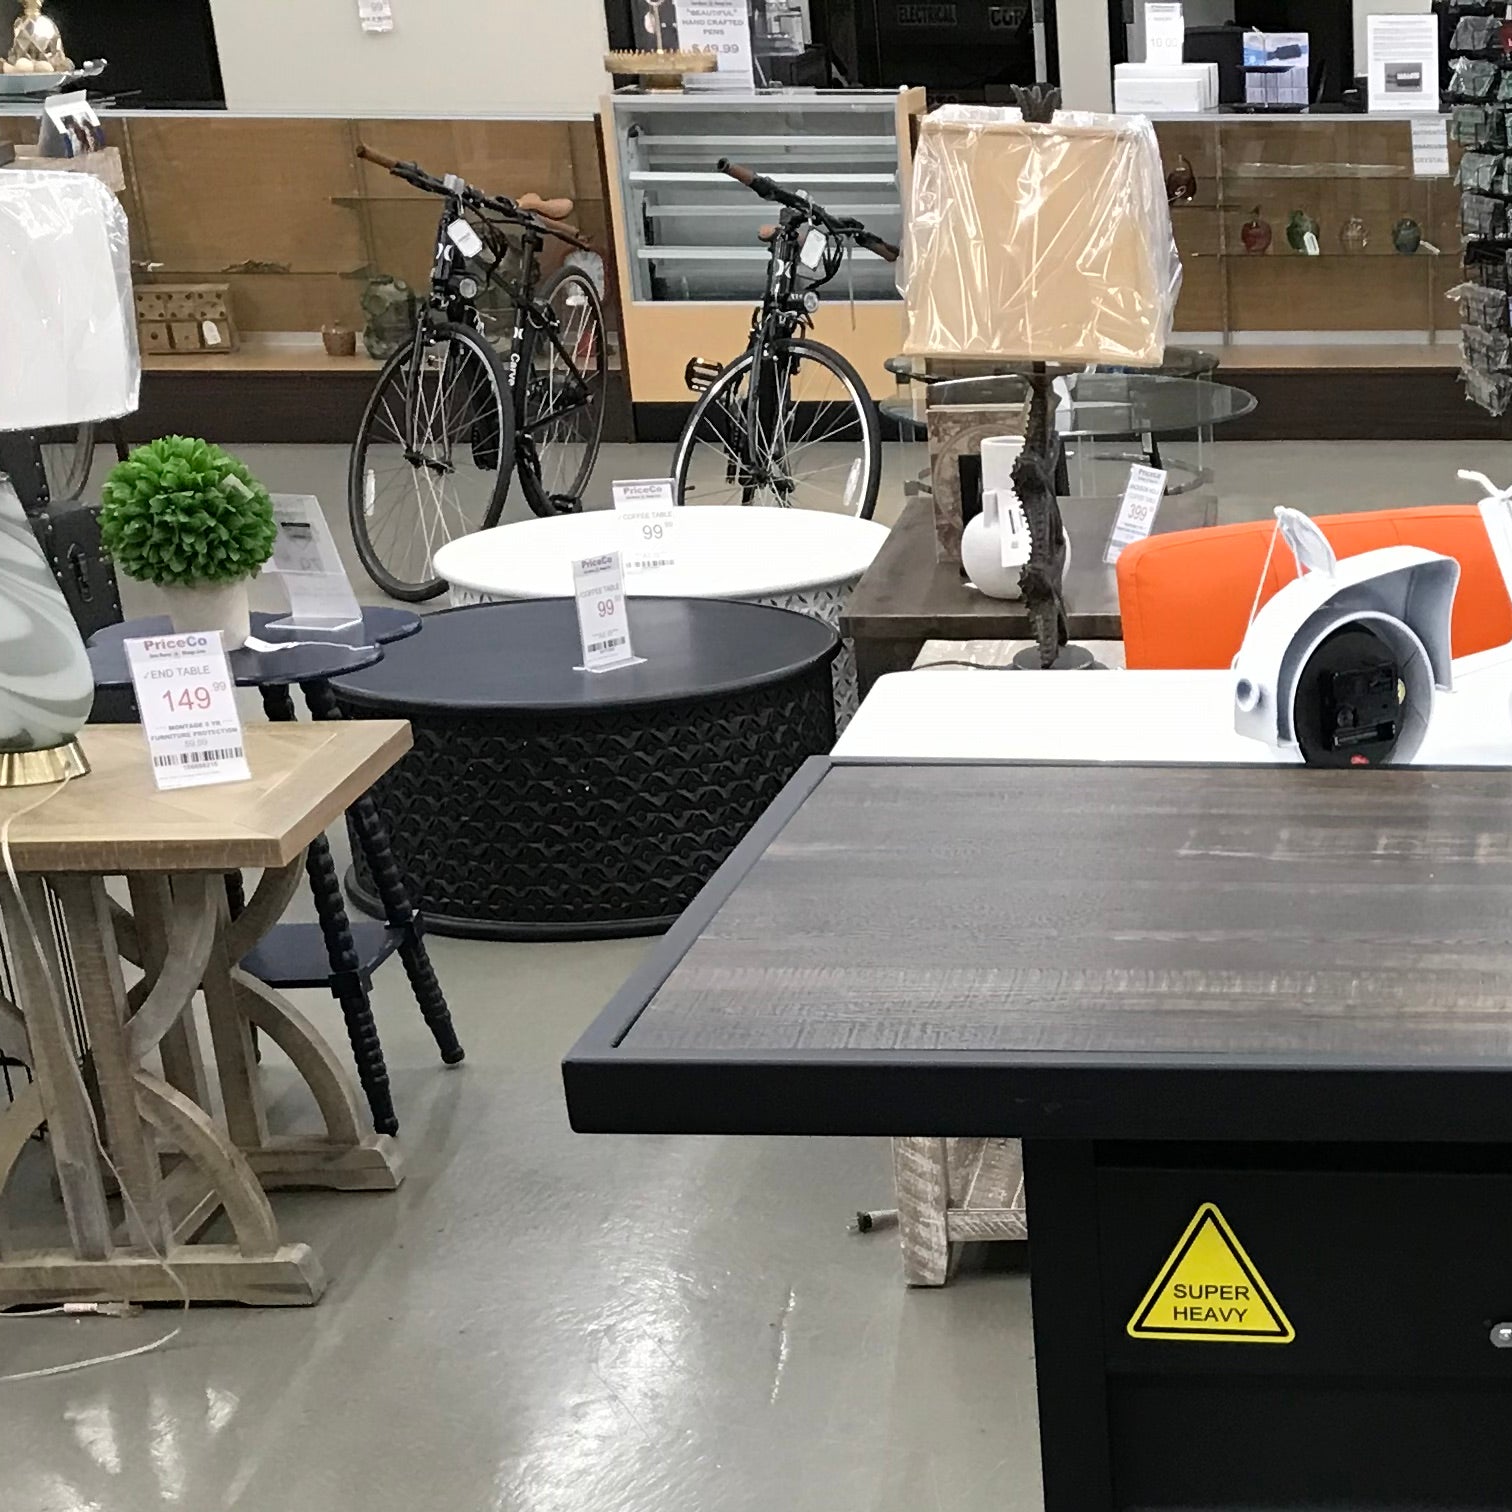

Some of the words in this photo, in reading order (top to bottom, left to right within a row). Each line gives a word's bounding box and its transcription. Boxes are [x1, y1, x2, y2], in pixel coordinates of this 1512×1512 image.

[508, 352, 521, 387] Carve
[623, 485, 662, 494] PriceCo
[622, 512, 650, 520] COFFEE
[1128, 503, 1147, 521] 399
[642, 524, 663, 540] 99
[597, 598, 615, 618] 99
[143, 636, 208, 651] PriceCo
[151, 668, 174, 680] END
[177, 665, 211, 677] TABLE
[162, 686, 212, 712] 149
[150, 732, 191, 741] FURNITURE
[193, 727, 238, 737] PROTECTION
[1173, 1283, 1250, 1301] SUPER
[1173, 1305, 1248, 1323] HEAVY
